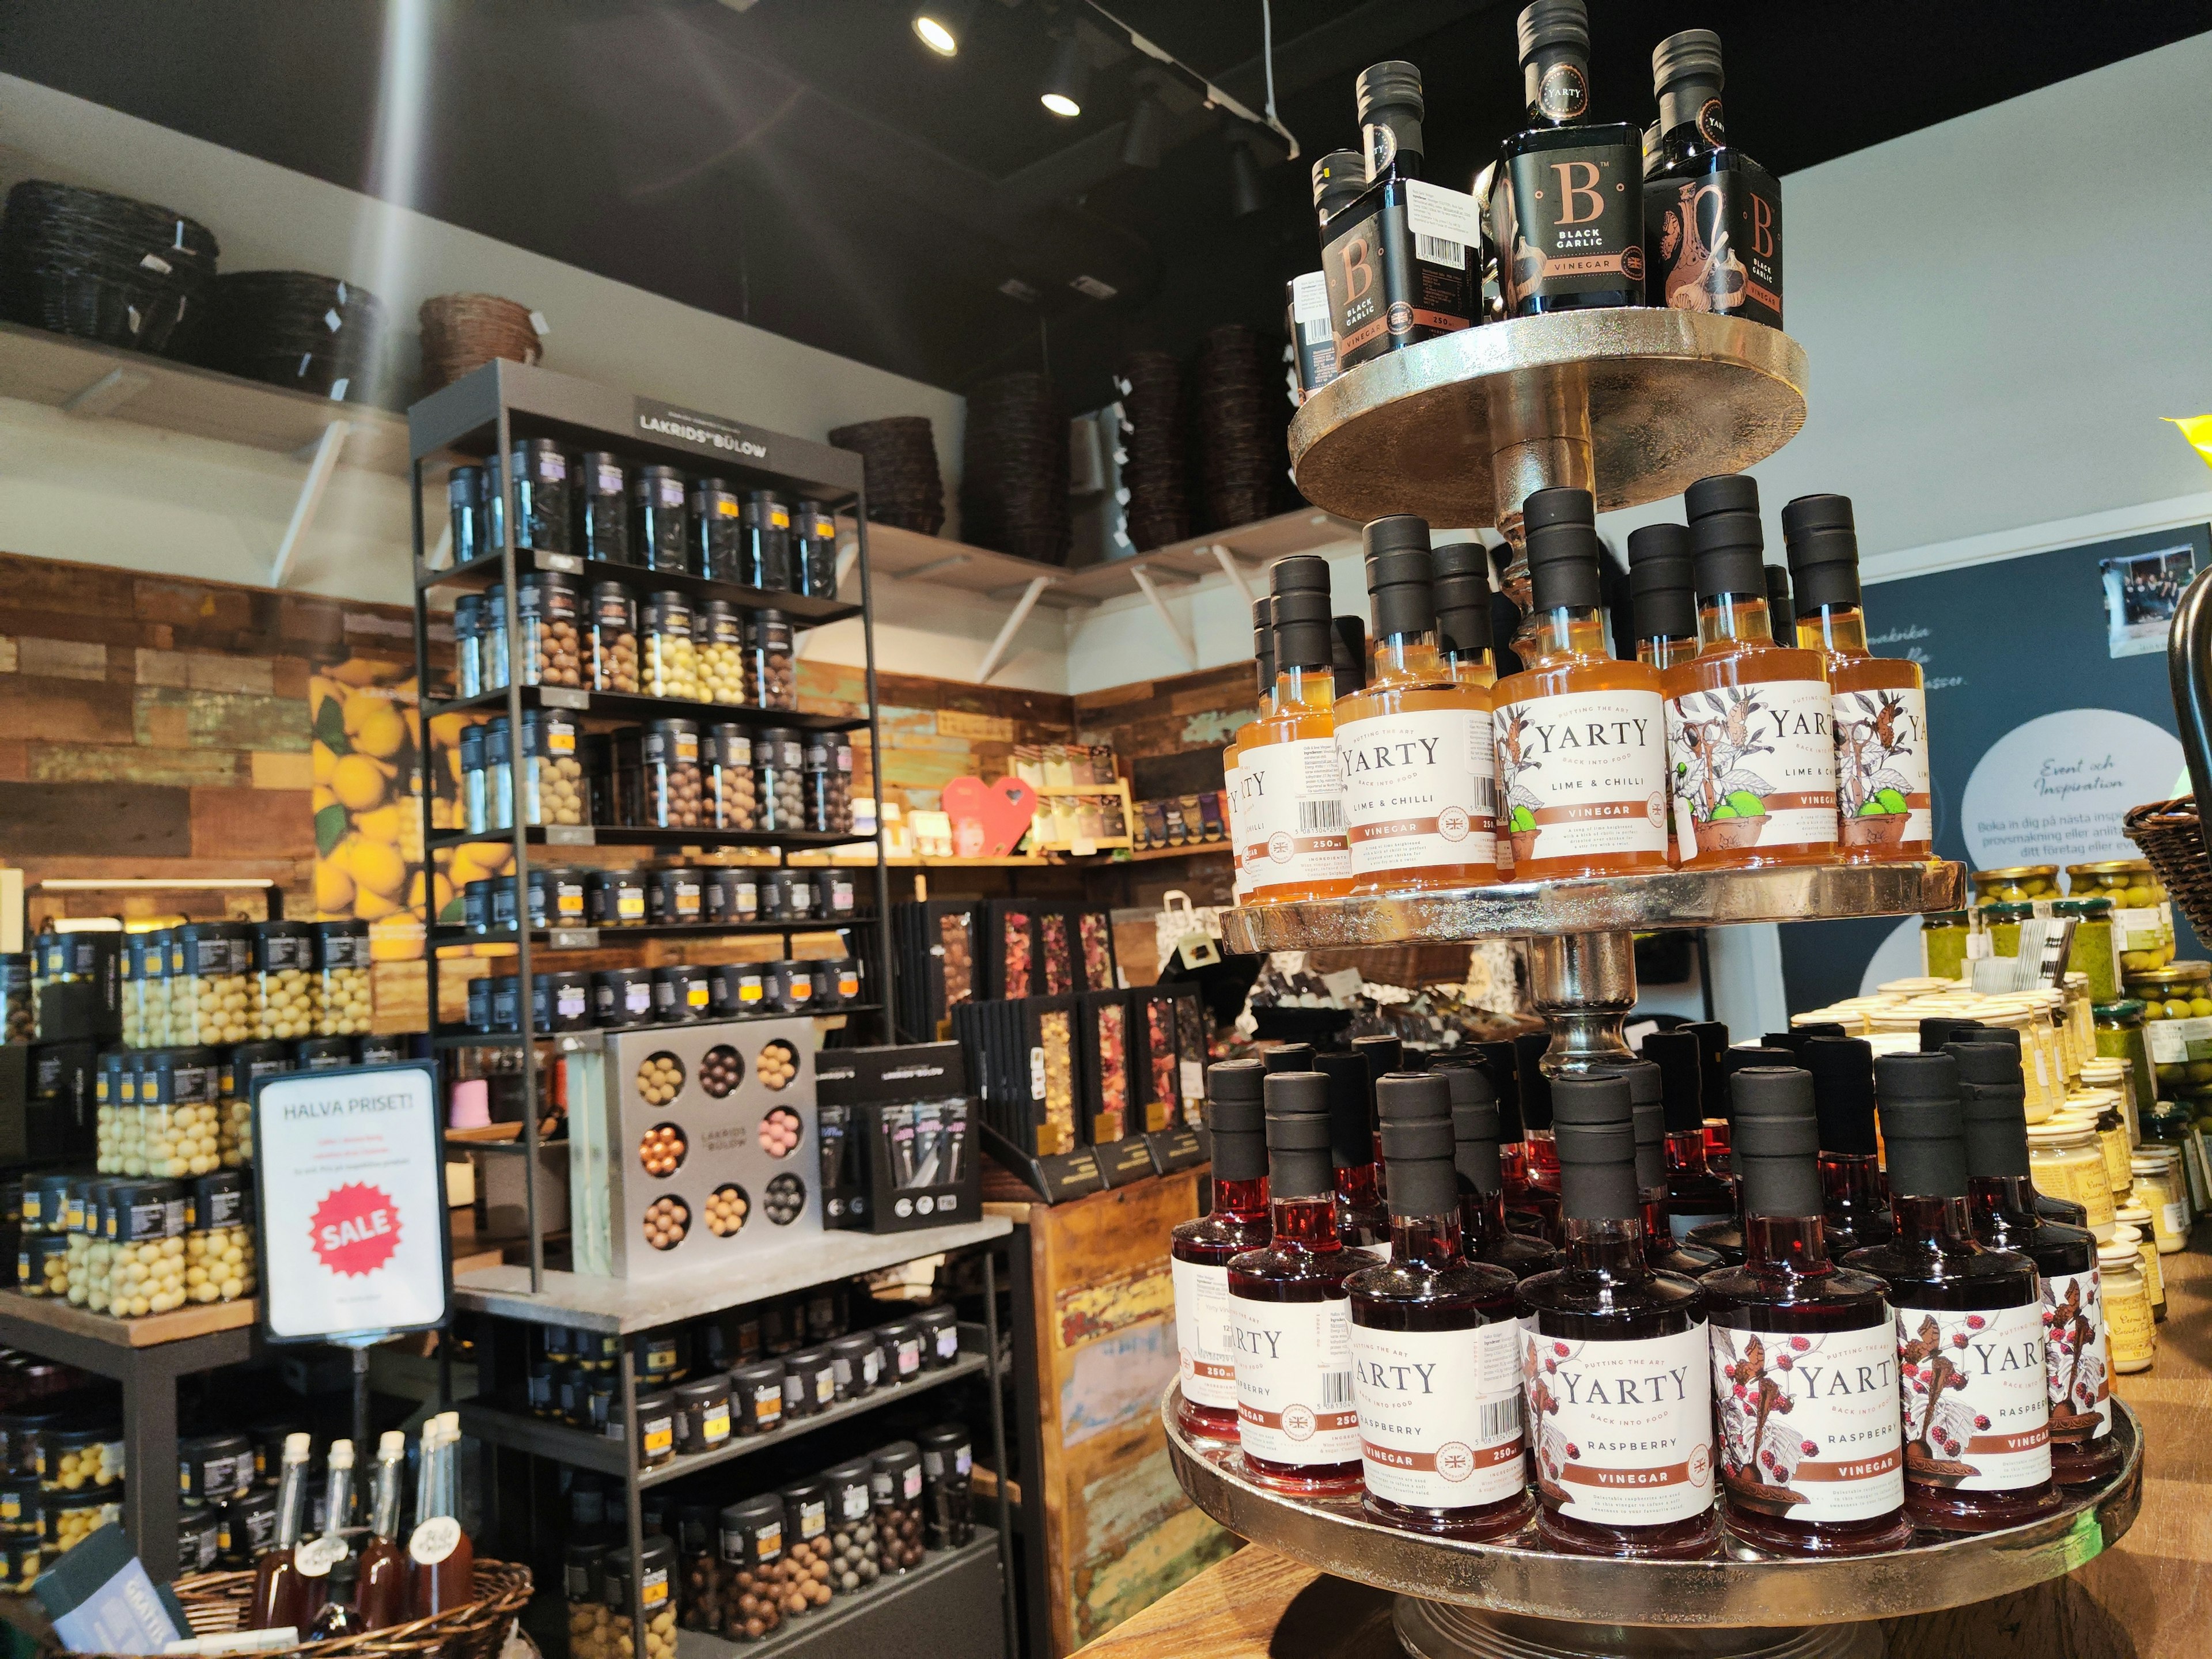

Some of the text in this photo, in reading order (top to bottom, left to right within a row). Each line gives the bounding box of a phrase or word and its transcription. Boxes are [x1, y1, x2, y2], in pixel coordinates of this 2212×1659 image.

[1548, 88, 1581, 98] YARTY
[1550, 162, 1604, 225] B
[1750, 193, 1773, 258] B
[1559, 229, 1600, 239] BLACK
[1556, 238, 1603, 248] GARLIC
[1338, 238, 1373, 306] B
[1554, 260, 1610, 271] VINEGAR
[1753, 257, 1771, 274] BLACK
[1752, 266, 1772, 283] GARLIC
[1751, 287, 1776, 306] VINEGAR
[1347, 297, 1372, 317] BLACK
[1346, 305, 1374, 327] GARLIC
[1347, 324, 1381, 347] VINEGAR
[1792, 695, 1818, 704] PUTTING
[1558, 706, 1593, 718] PUTTING
[1354, 730, 1380, 744] PUTTING
[1535, 719, 1647, 753] YARTY
[1796, 743, 1813, 752] BACK
[1342, 737, 1440, 777] YARTY
[1563, 757, 1584, 765] BACK
[1612, 753, 1631, 763] FOOD
[1785, 768, 1812, 776] LIME
[2041, 753, 2114, 777] Event och
[1397, 772, 1418, 783] FOOD
[1552, 778, 1643, 790] LIME & CHILLI
[2034, 777, 2124, 801] Inspiration
[1354, 801, 1374, 812] LIME
[1391, 795, 1433, 805] CHILLI
[1568, 806, 1630, 818] VINEGAR
[1978, 813, 2091, 832] Boka in dig på nästa
[1364, 823, 1417, 837] VINEGAR
[1313, 840, 1342, 848] 250ml
[1982, 830, 2089, 848] provsmakning eller
[2021, 840, 2112, 858] ditt företag eller
[284, 1096, 343, 1120] HALVA
[321, 1208, 392, 1251] SALE
[2000, 1324, 2028, 1337] PUTTING
[1393, 1350, 1408, 1358] ART
[1827, 1348, 1862, 1361] PUTTING
[1207, 1366, 1234, 1377] 250ml
[1585, 1360, 1624, 1369] PUTTING
[1560, 1366, 1688, 1404] YARTY
[2003, 1380, 2038, 1389] BACK INTO
[1325, 1402, 1351, 1410] 081304
[1374, 1400, 1389, 1408] INTO
[1392, 1400, 1412, 1408] FOOD
[1832, 1395, 1893, 1415] BACK INTO FOOD
[1361, 1414, 1422, 1435] RASPBERRY
[1591, 1414, 1615, 1425] BACK
[1646, 1411, 1668, 1423] FOOD
[1483, 1433, 1506, 1444] 081304
[1828, 1422, 1897, 1444] RASPBERRY
[1588, 1438, 1677, 1451] RASPBERRY
[1366, 1445, 1414, 1465] VINEGAR
[1493, 1447, 1517, 1460] 250ml
[1838, 1457, 1893, 1477] VINEGAR
[1598, 1472, 1668, 1484] VINEGAR
